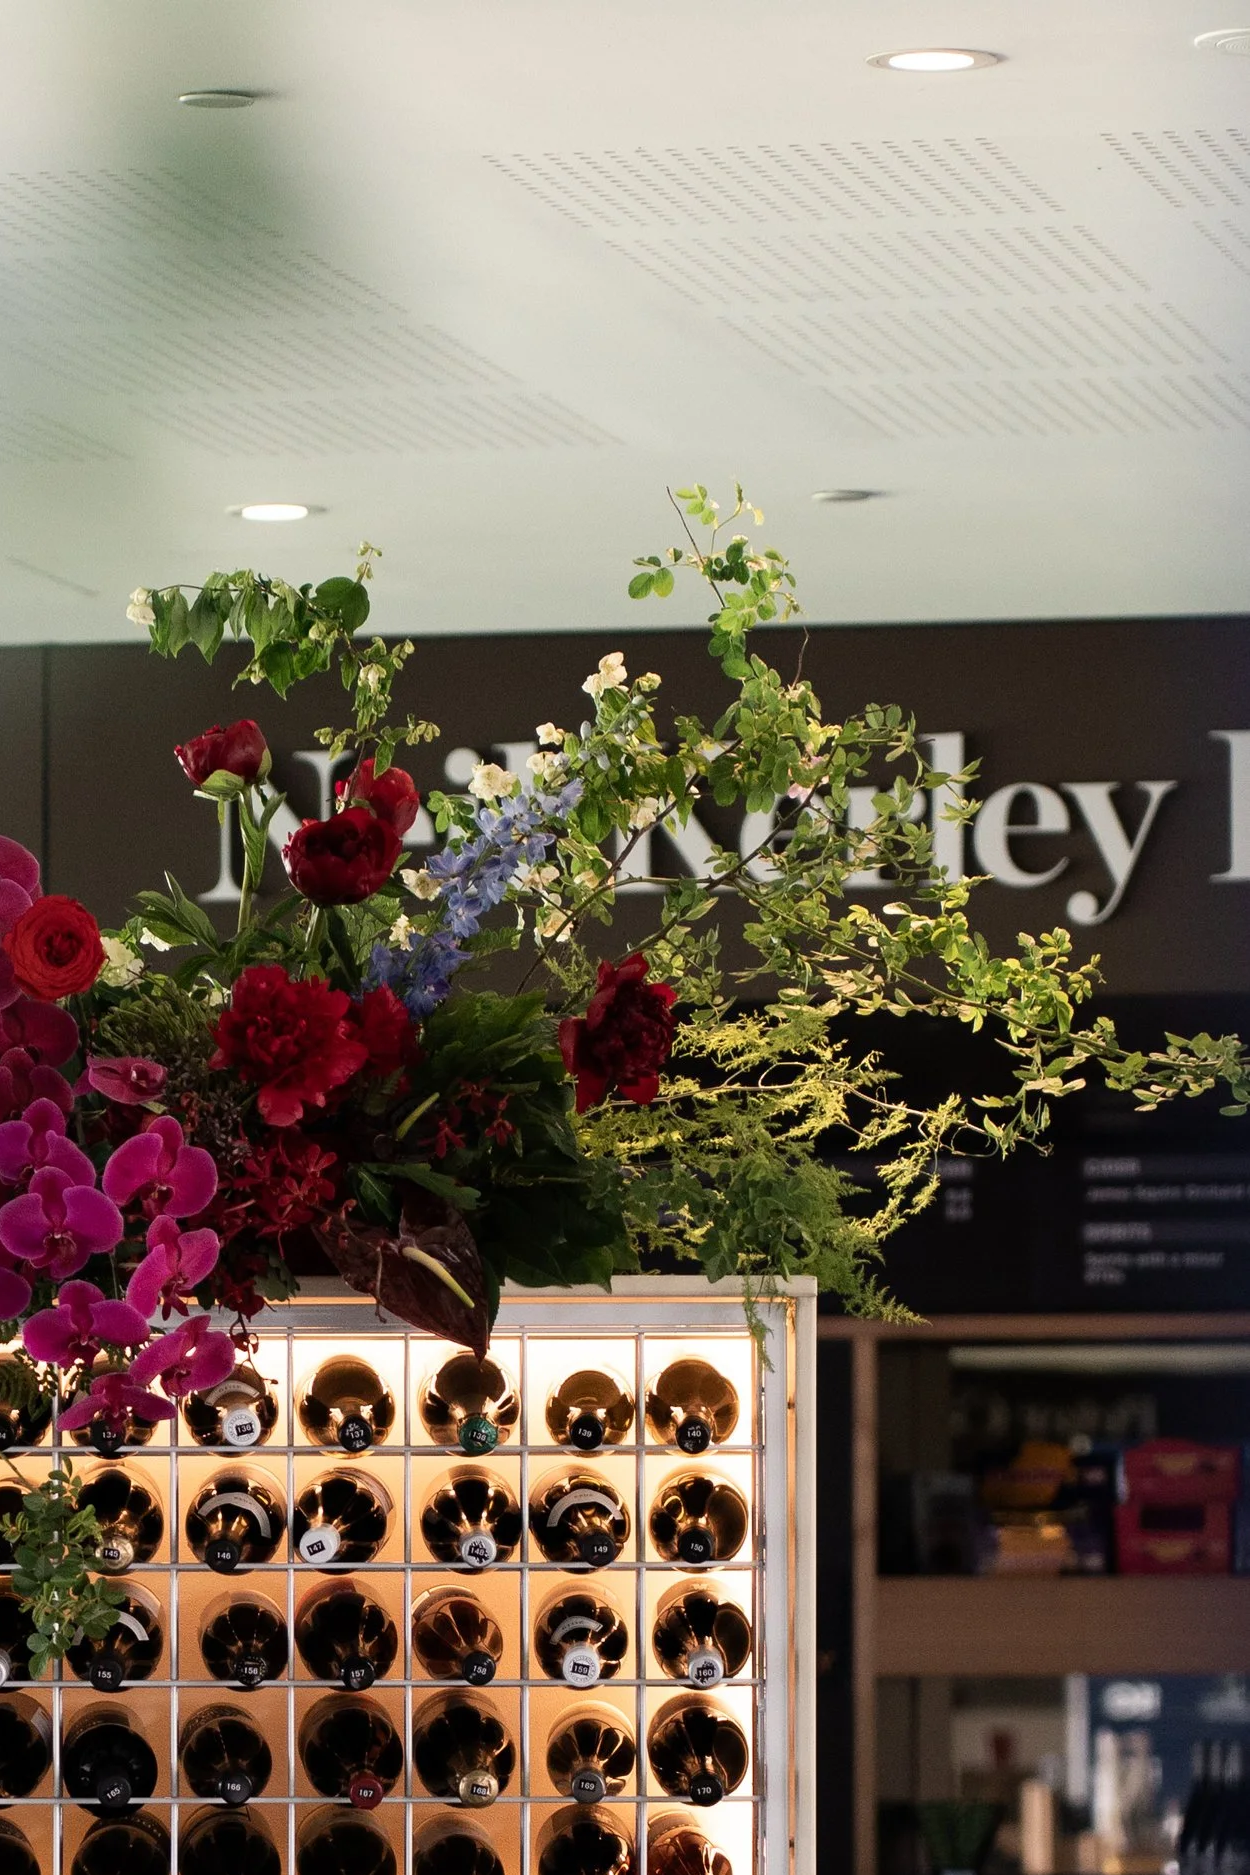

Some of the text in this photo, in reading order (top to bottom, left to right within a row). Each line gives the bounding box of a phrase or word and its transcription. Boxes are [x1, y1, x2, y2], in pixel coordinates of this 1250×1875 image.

[195, 740, 545, 902] Nil
[237, 1424, 251, 1433] 136
[578, 1428, 592, 1438] 139
[350, 1429, 364, 1438] 137
[473, 1431, 487, 1441] 138
[309, 1543, 321, 1553] 147
[471, 1547, 485, 1556] 148
[691, 1543, 704, 1552] 150
[105, 1550, 118, 1558] 145
[244, 1667, 258, 1675] 156
[351, 1669, 365, 1678] 157
[473, 1665, 487, 1675] 158
[574, 1665, 588, 1674] 159
[699, 1669, 713, 1677] 160
[98, 1671, 112, 1679] 155
[227, 1783, 241, 1791] 166
[473, 1786, 487, 1795] 168
[581, 1782, 595, 1790] 169
[107, 1787, 120, 1799] 165
[359, 1789, 373, 1797] 167
[697, 1787, 712, 1795] 170
